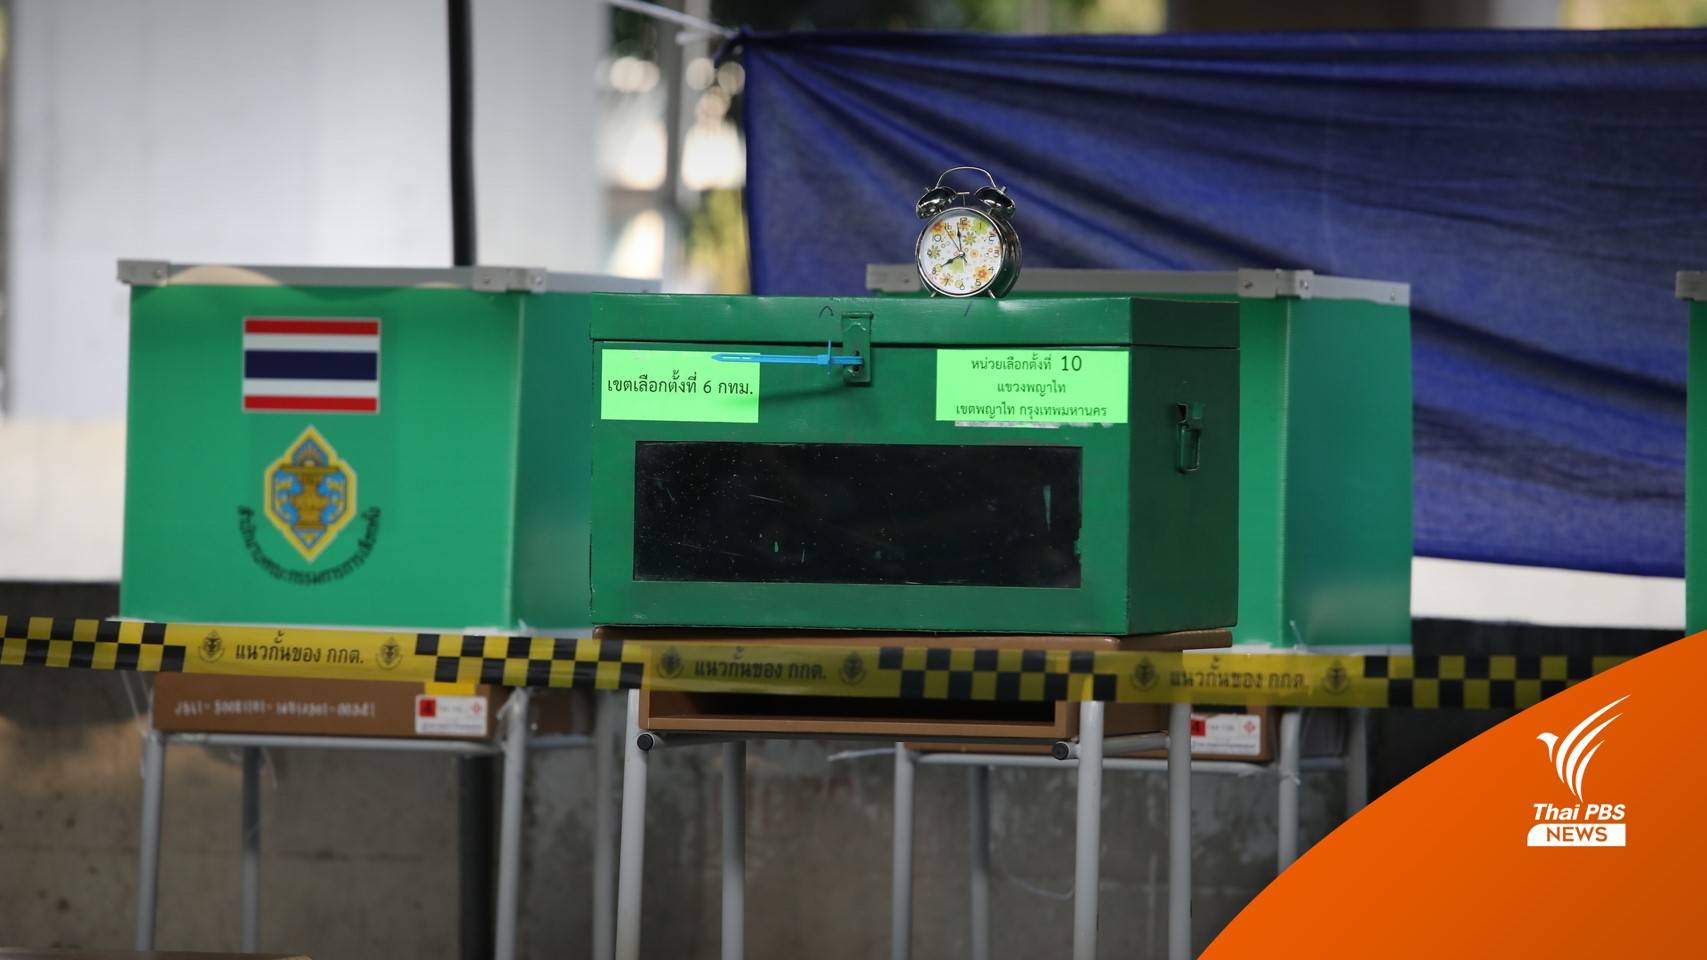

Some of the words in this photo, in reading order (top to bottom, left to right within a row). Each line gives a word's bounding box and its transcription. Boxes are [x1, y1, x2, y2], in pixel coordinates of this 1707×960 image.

[971, 353, 1052, 371] หน่วยเลือกตั้งที่
[1060, 355, 1083, 372] 10
[607, 369, 697, 393] เขตเลือกตั้งที่
[703, 380, 712, 394] 6
[718, 381, 754, 395] กทม.
[997, 379, 1066, 397] แขวงพญาไท
[956, 402, 1015, 419] เขตพญาไท
[1019, 404, 1107, 420] กรุงเทพมหานคร
[235, 630, 321, 663] แนวกั้นของ
[326, 649, 364, 665] กกต.
[695, 646, 783, 679] แนวกั้นของ
[788, 662, 827, 680] กกต.
[1170, 656, 1262, 688] แนวกั้นของ
